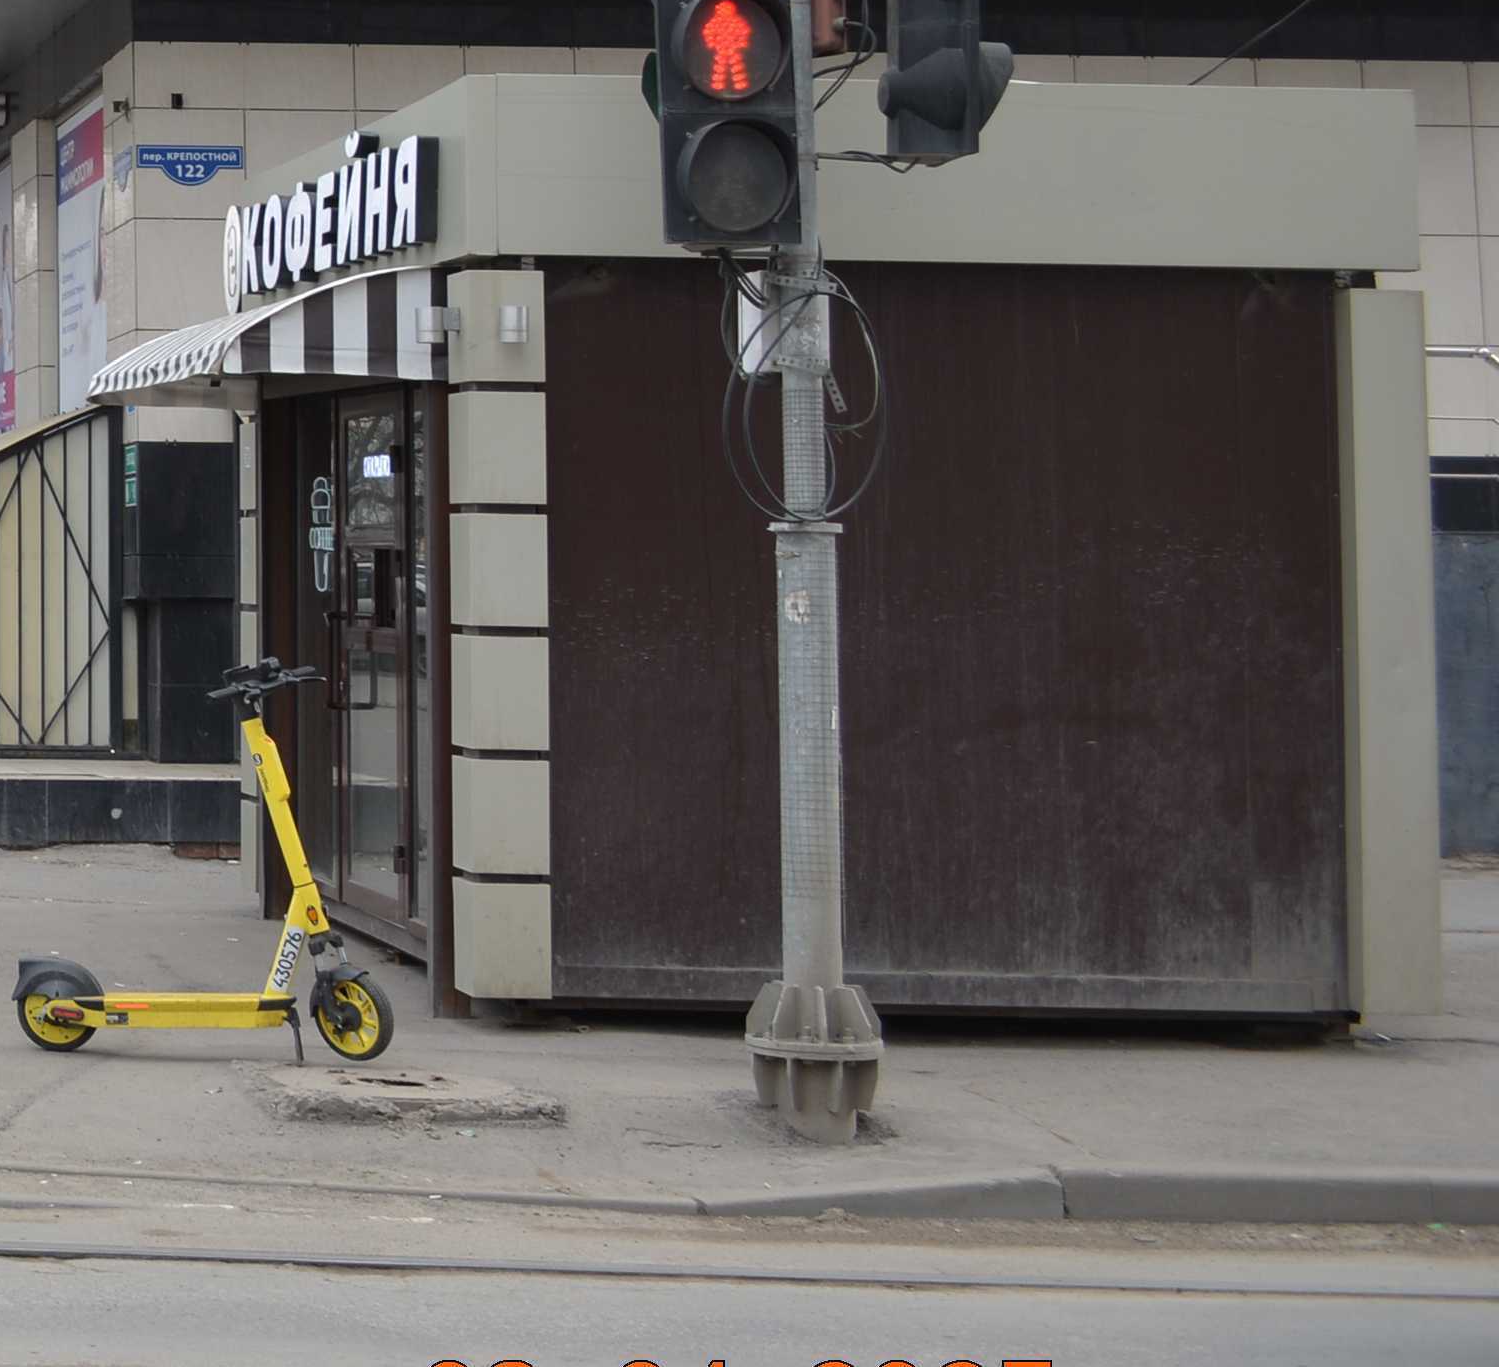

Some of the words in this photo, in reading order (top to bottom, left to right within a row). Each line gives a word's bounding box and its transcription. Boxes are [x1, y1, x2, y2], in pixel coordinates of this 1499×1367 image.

[143, 153, 164, 163] пер.
[166, 151, 237, 162] КРЕПОСТНОЙ
[175, 164, 205, 178] 122
[241, 130, 430, 295] КОФЕЙНЯ
[273, 932, 303, 988] 430576
